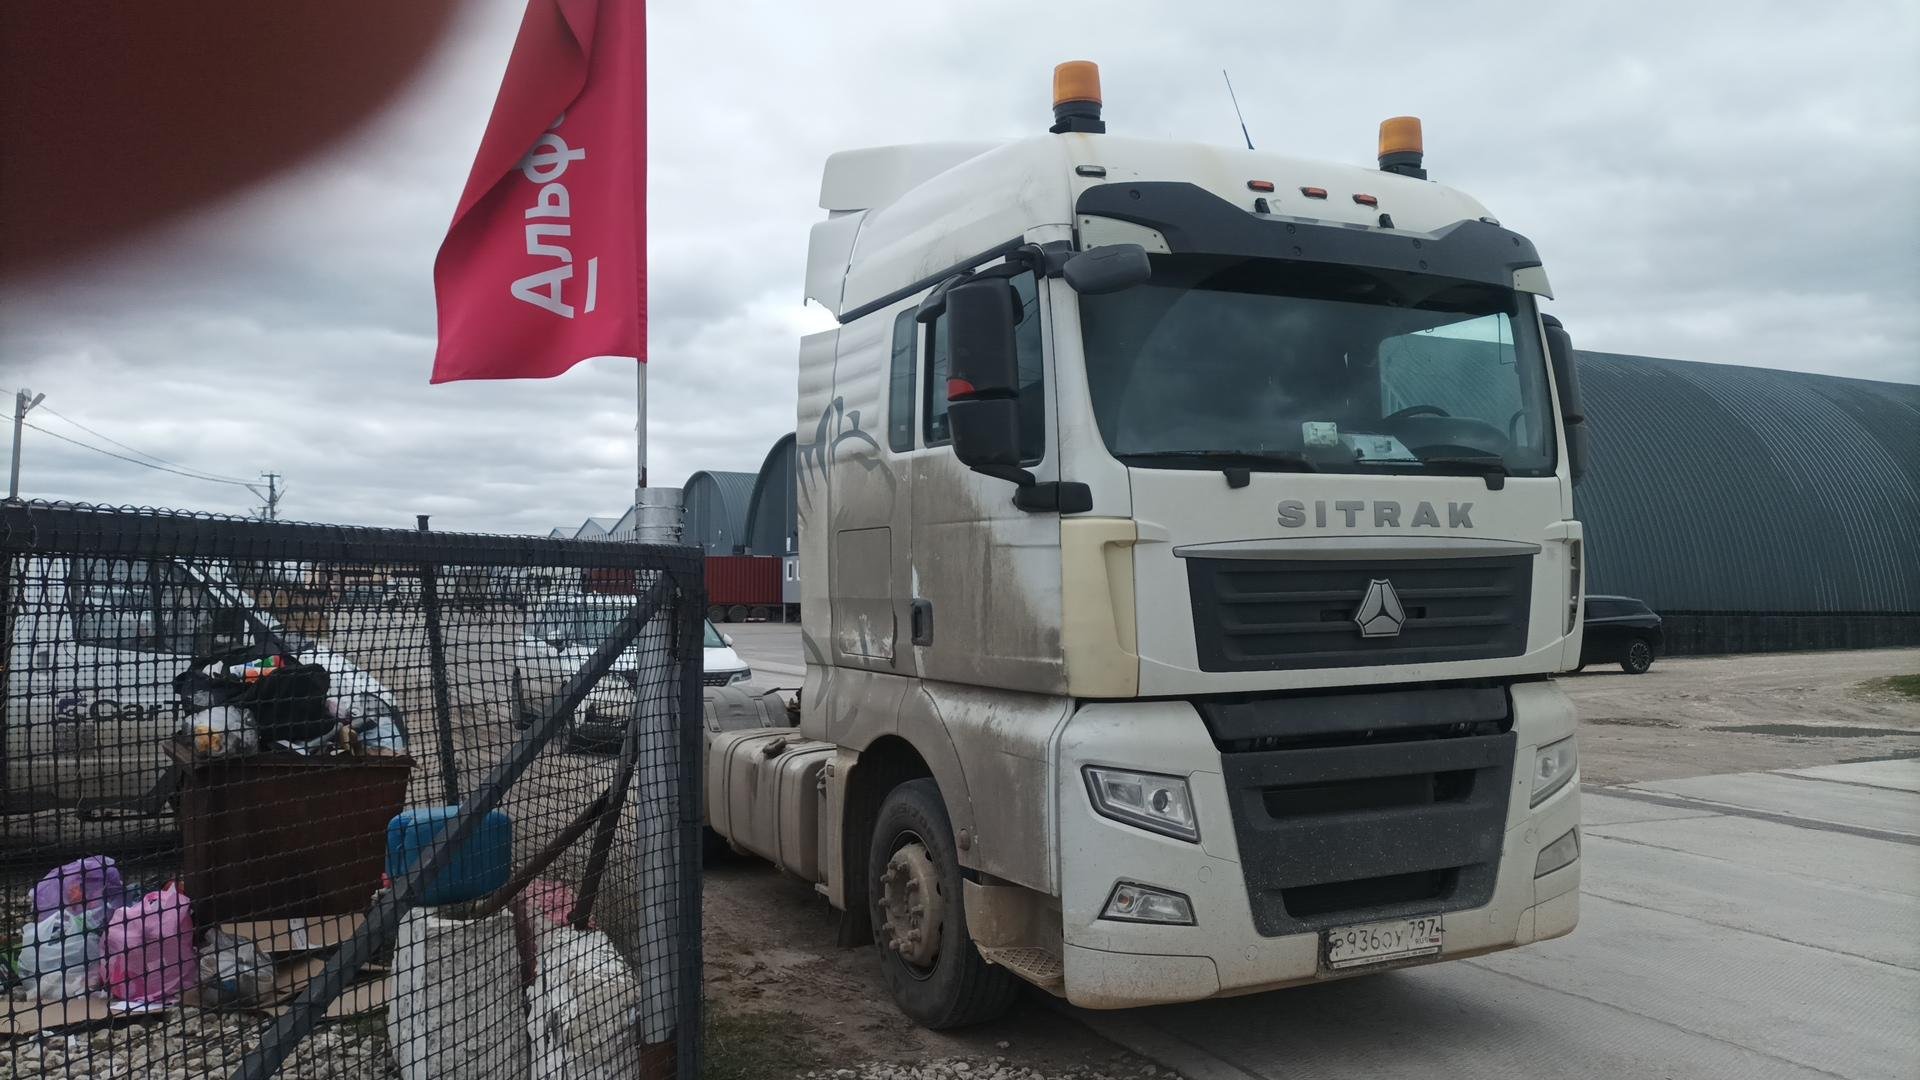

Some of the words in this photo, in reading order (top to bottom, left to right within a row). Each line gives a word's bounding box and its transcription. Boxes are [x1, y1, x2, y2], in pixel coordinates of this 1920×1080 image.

[511, 112, 585, 318] Альф
[1277, 500, 1475, 528] SITRAK
[89, 699, 184, 721] CarT
[1409, 919, 1436, 938] 797
